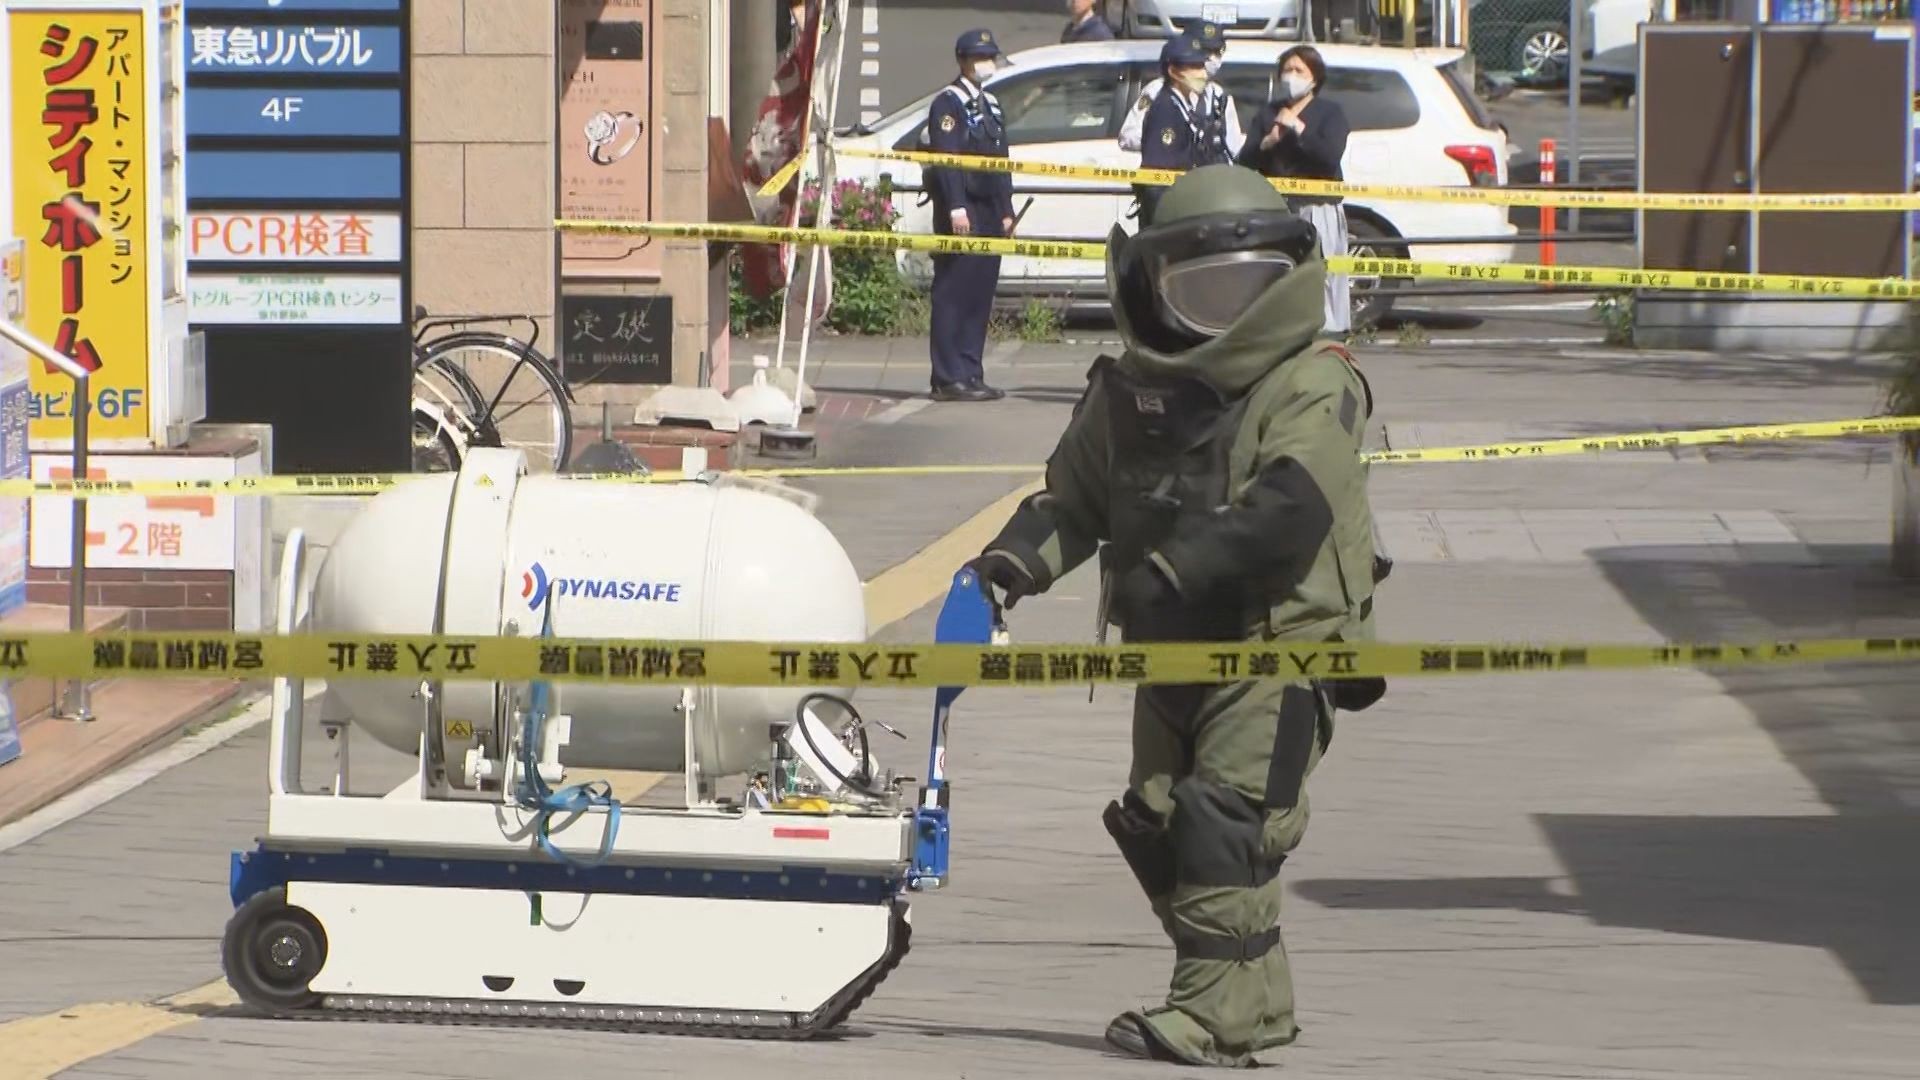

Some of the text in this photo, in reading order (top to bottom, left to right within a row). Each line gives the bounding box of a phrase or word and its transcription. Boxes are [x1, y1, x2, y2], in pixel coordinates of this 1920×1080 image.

[191, 27, 373, 66] 東急リバブル
[261, 97, 304, 122] 4F
[105, 28, 133, 285] アパート・マンション
[40, 24, 103, 375] シティホーム
[190, 215, 374, 257] PCR検査
[117, 522, 183, 557] 2階
[94, 639, 264, 671] 宮城県警察
[328, 641, 477, 673] 立入禁止
[539, 645, 707, 678] 宮城県警察
[769, 649, 919, 681] 立入禁止
[979, 652, 1148, 681] 宮城県警察
[1208, 652, 1360, 677] 立入禁止
